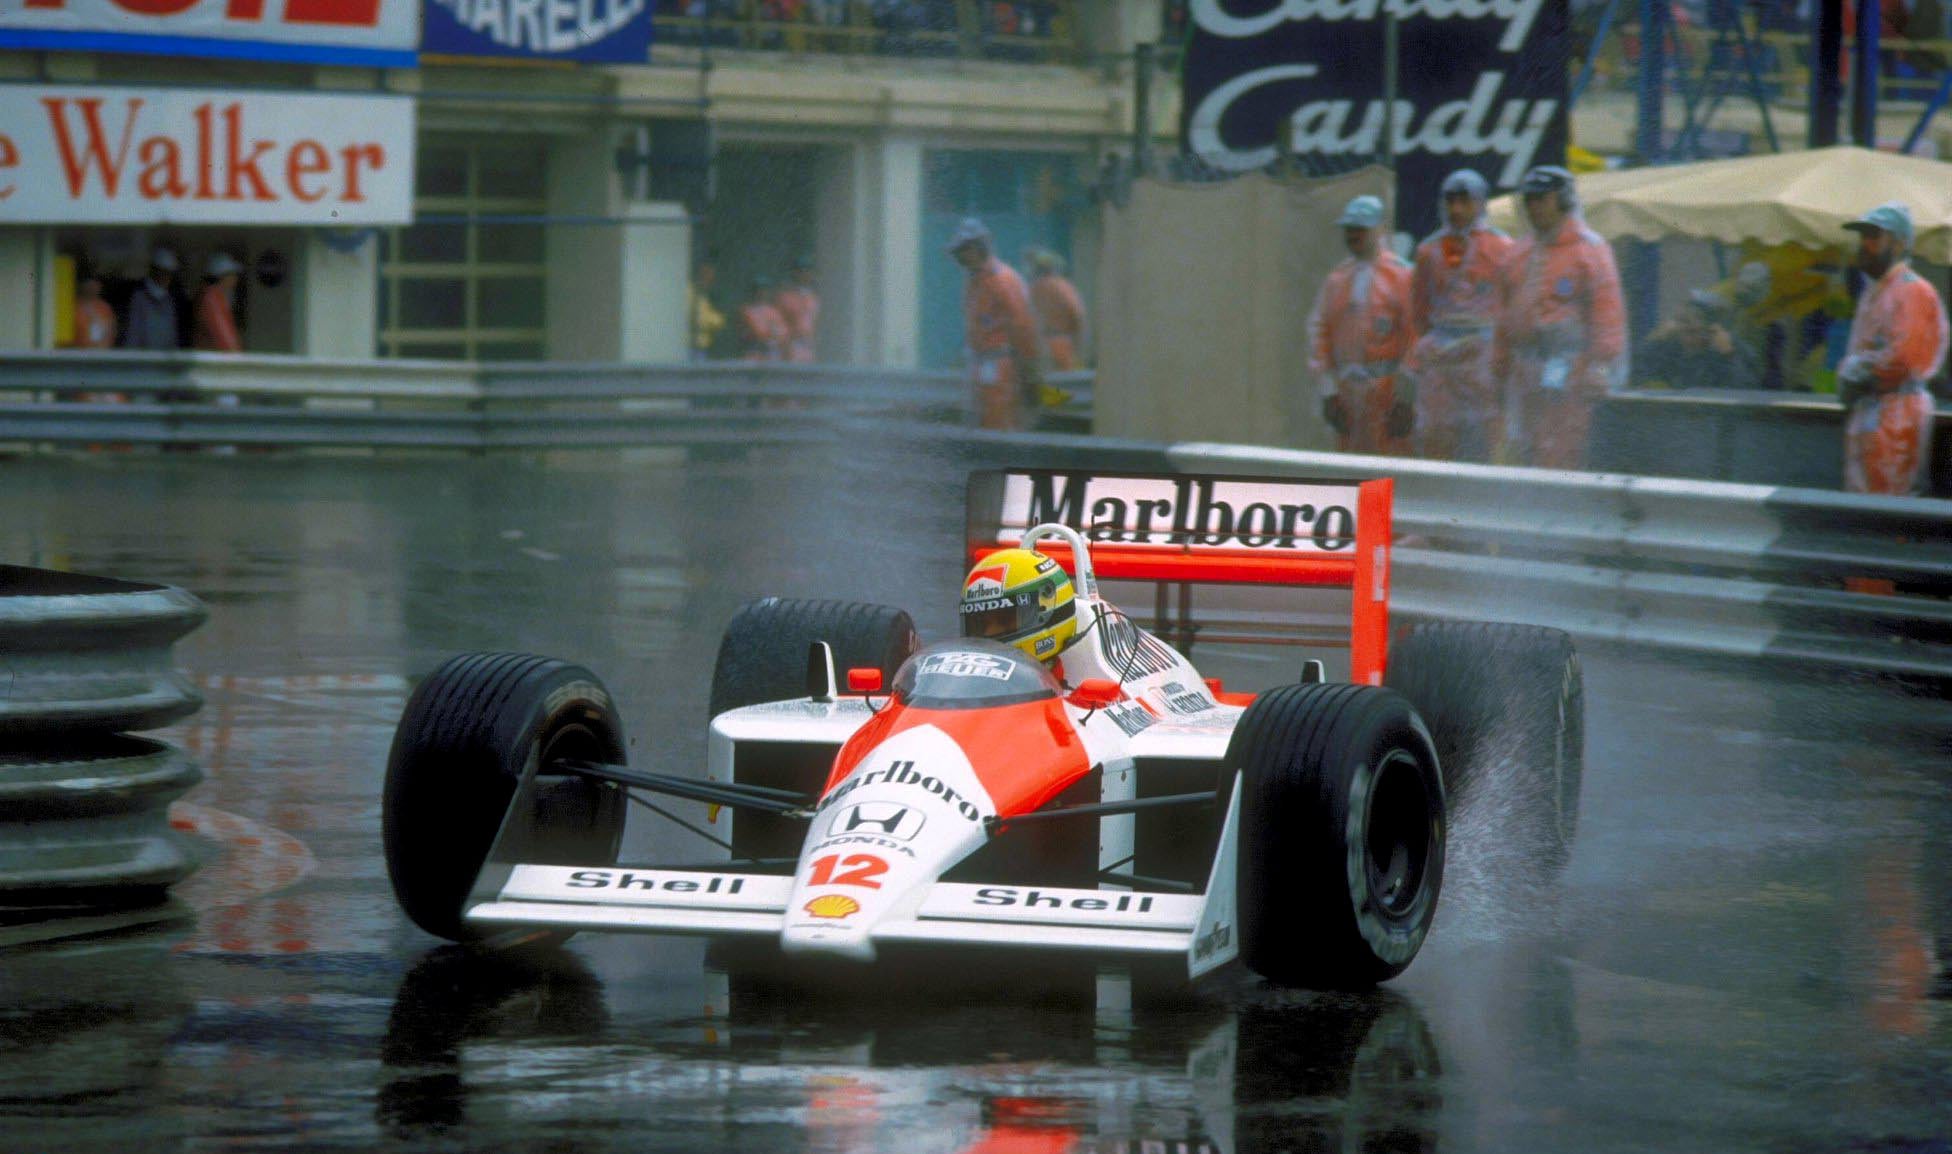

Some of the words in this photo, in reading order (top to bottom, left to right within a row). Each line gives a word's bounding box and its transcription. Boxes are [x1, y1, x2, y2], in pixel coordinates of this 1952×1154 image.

[40, 97, 386, 203] Walker
[1189, 64, 1558, 188] Candy
[1028, 473, 1354, 551] Marlboro
[565, 870, 745, 895] Shell
[807, 853, 890, 890] 12
[973, 888, 1153, 913] Shell
